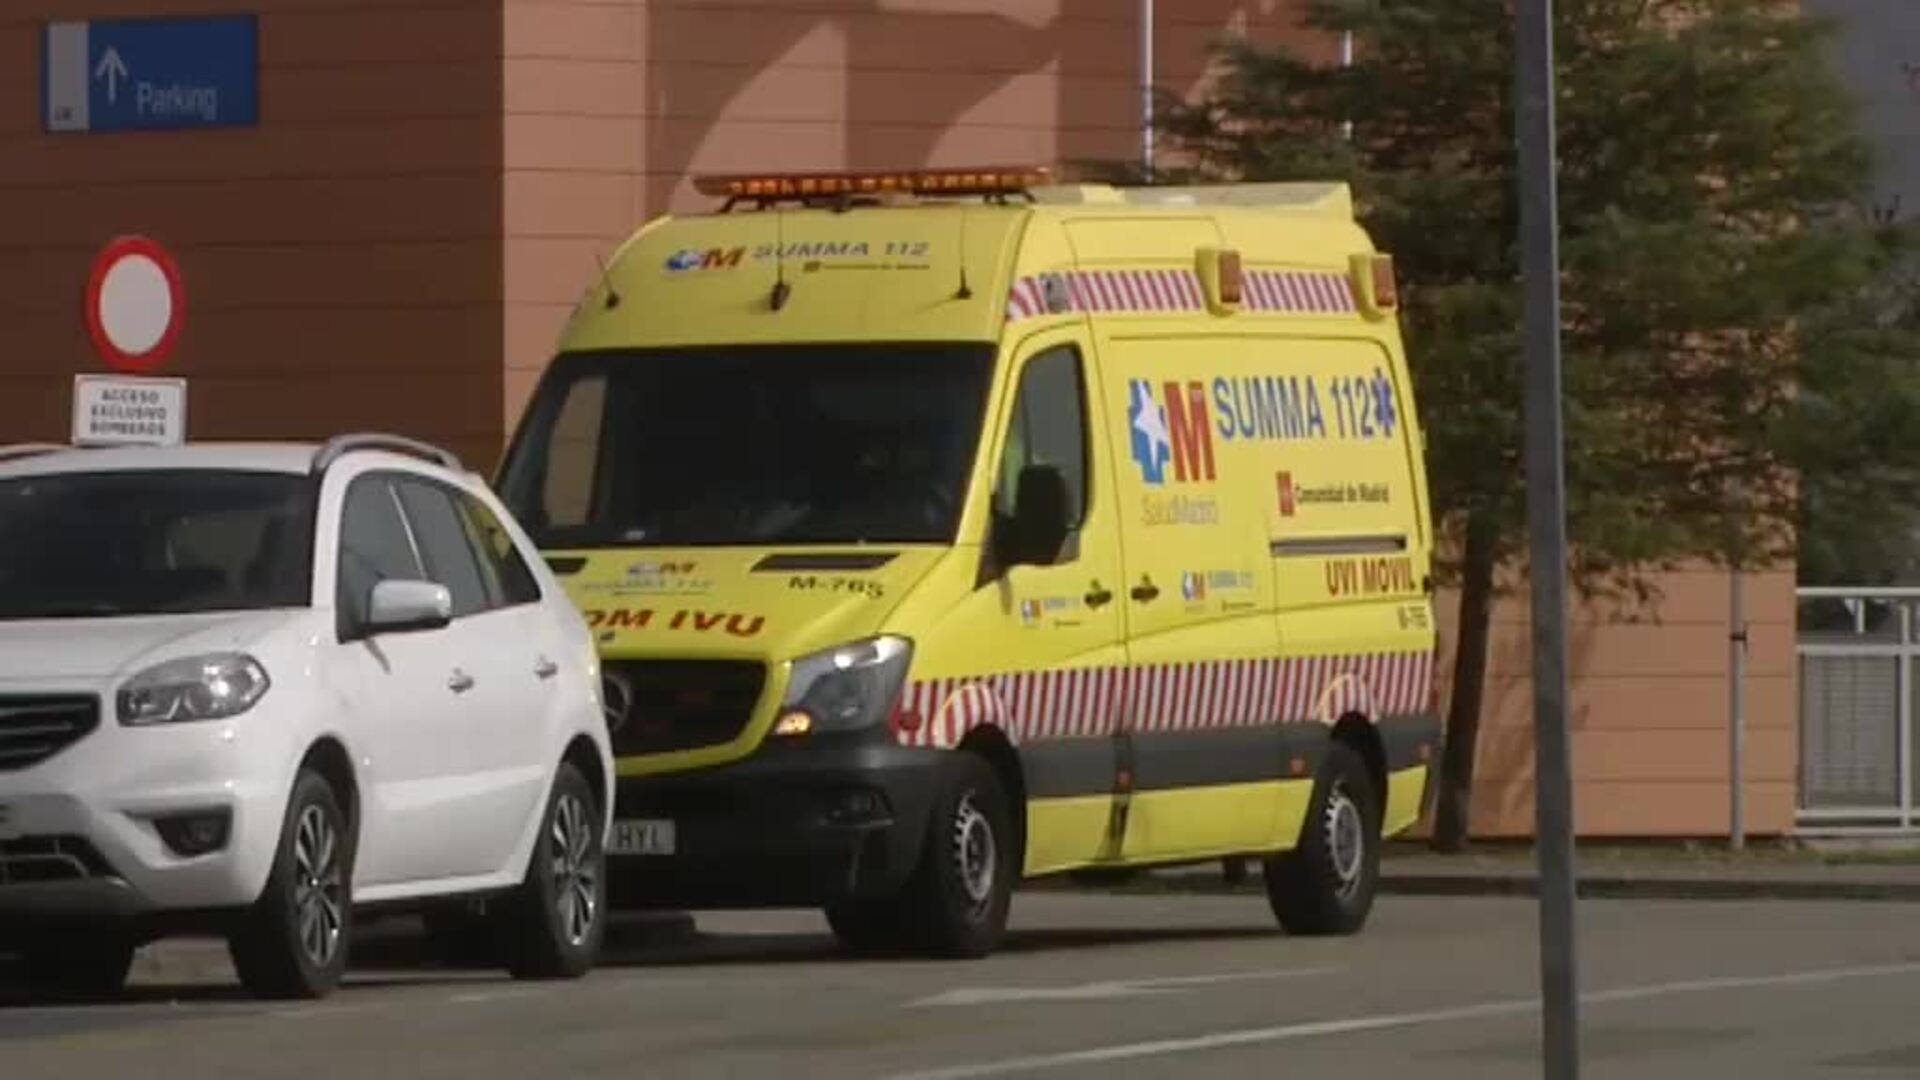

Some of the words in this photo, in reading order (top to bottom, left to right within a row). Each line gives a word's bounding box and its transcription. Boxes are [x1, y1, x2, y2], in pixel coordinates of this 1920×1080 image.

[136, 81, 217, 120] Parking
[1212, 376, 1327, 439] SUMMA
[1329, 376, 1374, 437] 112
[1325, 565, 1359, 597] UVI
